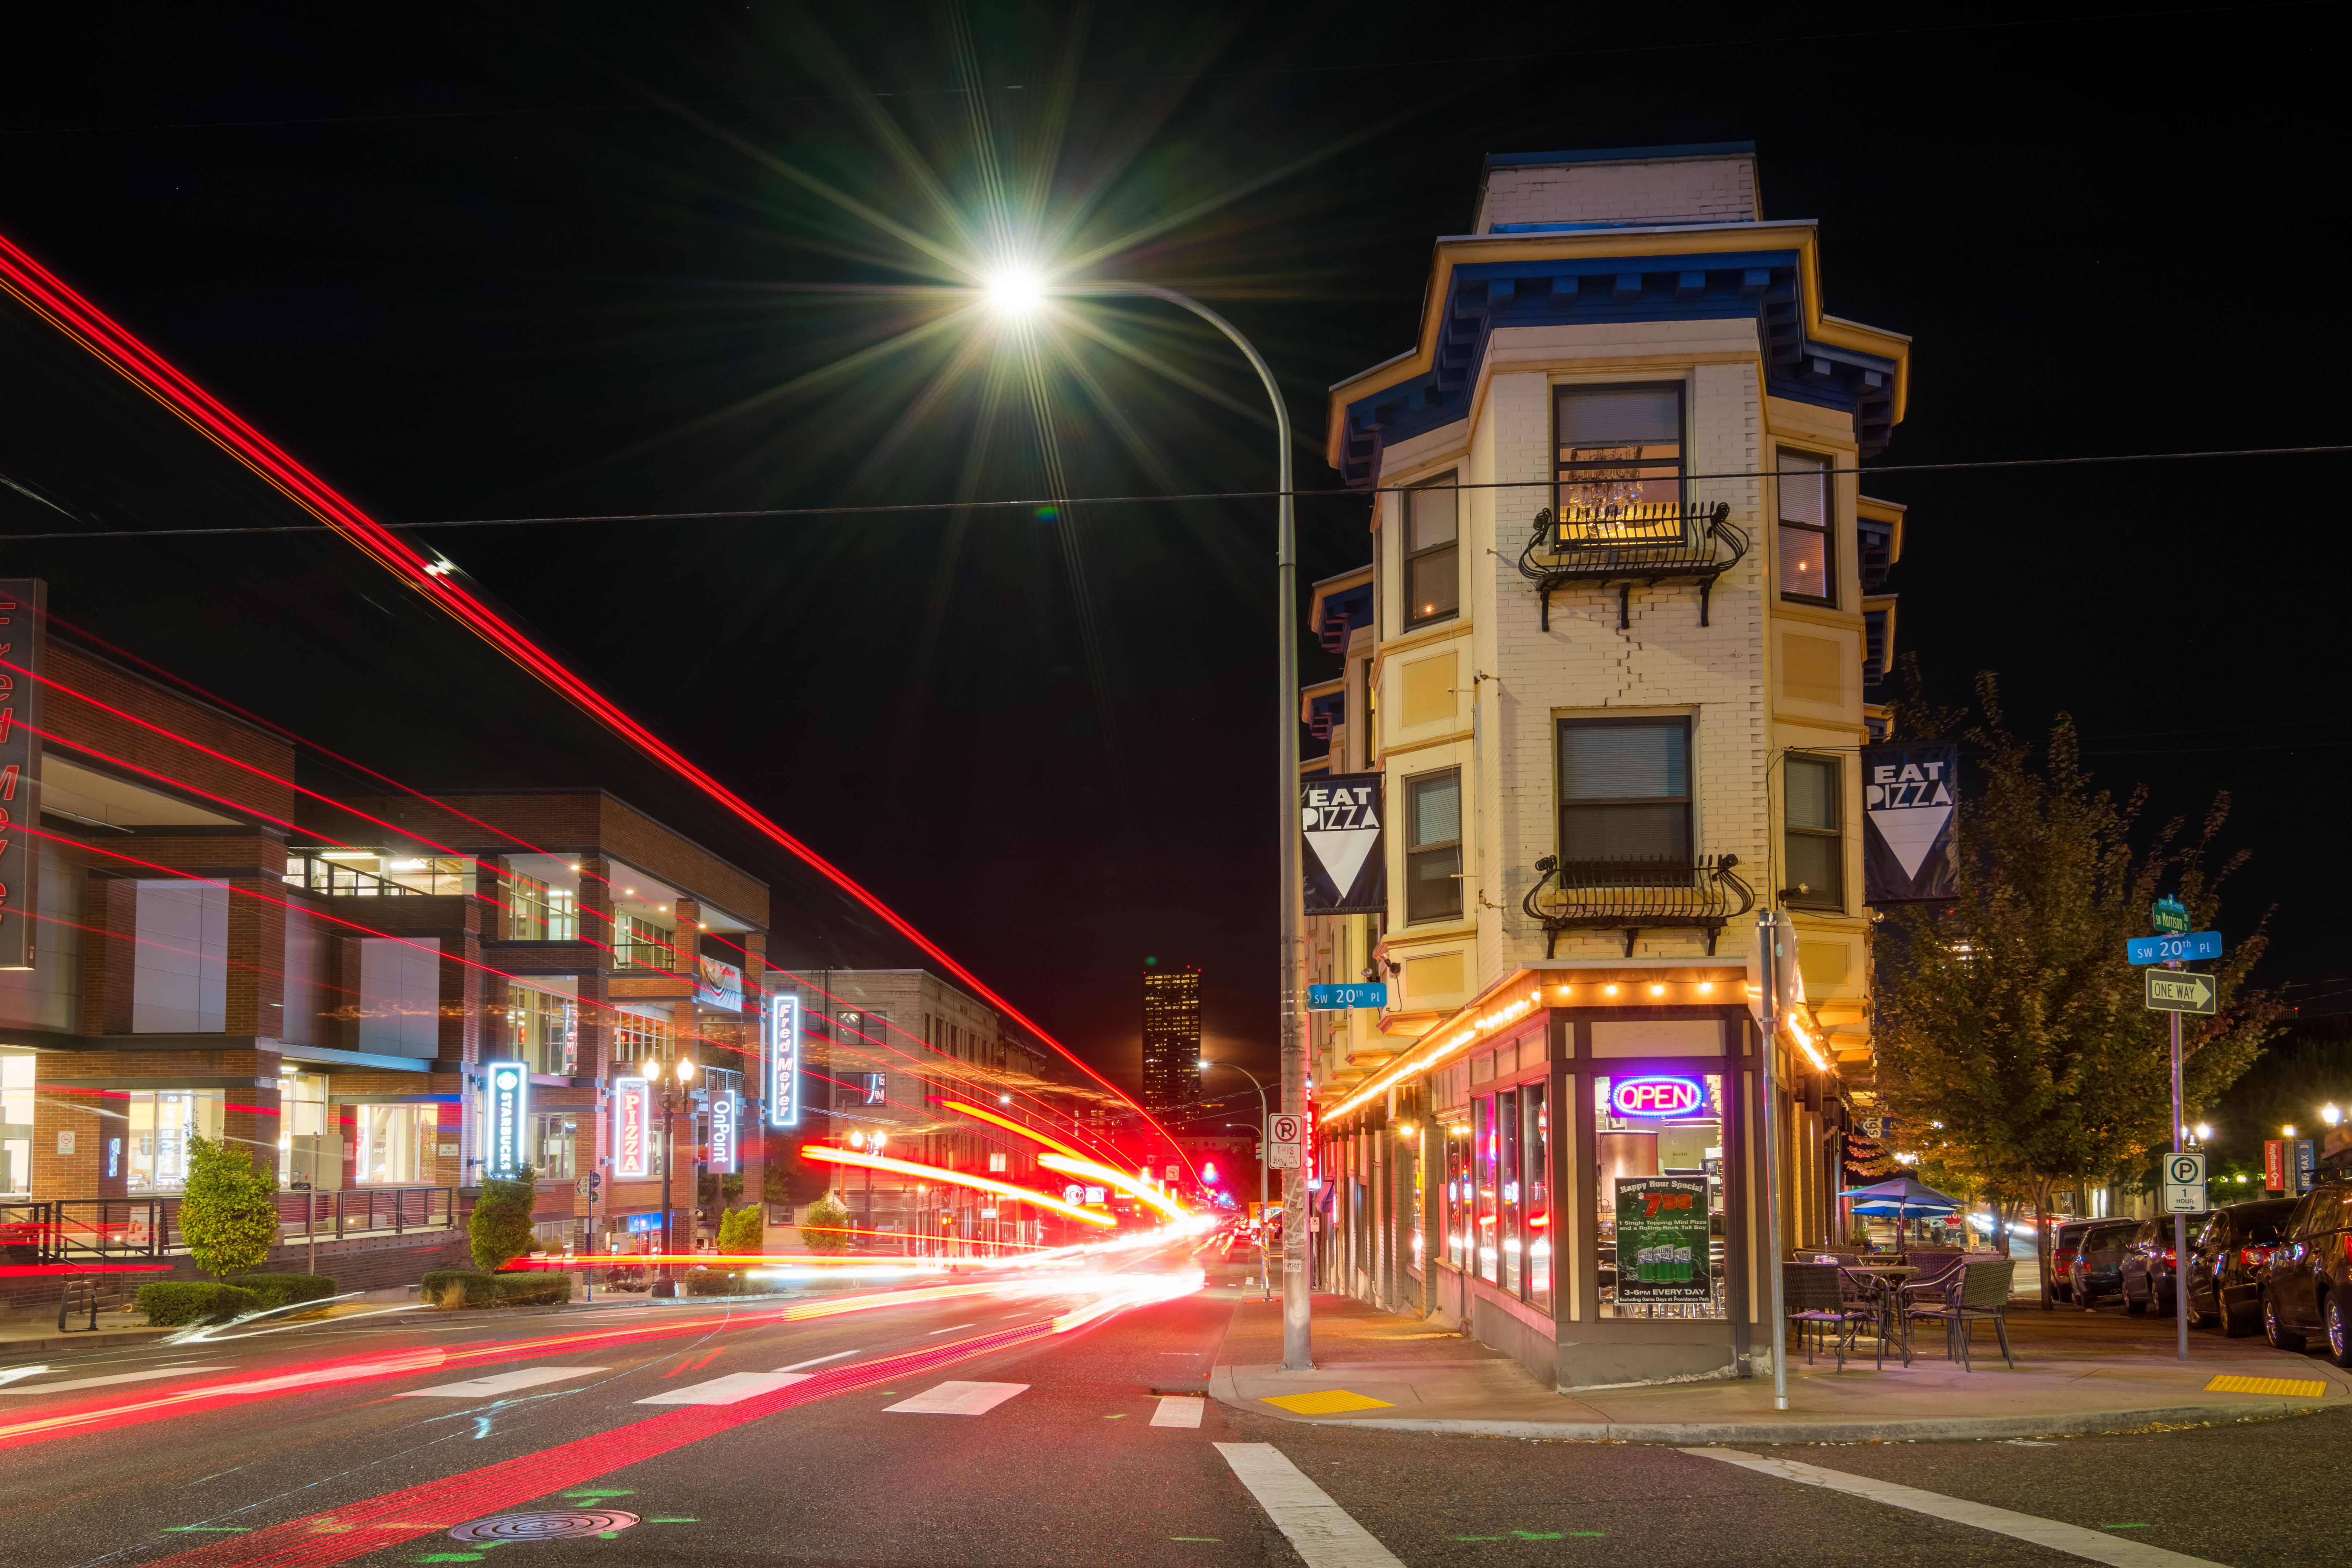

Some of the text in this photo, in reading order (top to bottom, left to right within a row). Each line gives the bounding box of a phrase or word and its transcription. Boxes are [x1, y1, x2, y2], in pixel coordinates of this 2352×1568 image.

[1874, 762, 1944, 784] EAT
[1309, 787, 1371, 807] EAT
[1867, 781, 1952, 809] PIZZA
[1302, 805, 1380, 831] PIZZA
[2162, 912, 2182, 930] Morrison
[2137, 940, 2210, 958] SW 20th Pl
[1315, 989, 1380, 1004] SW 20th Pl
[2155, 983, 2194, 1000] ONE WAY
[777, 1004, 793, 1116] Fred Meyer
[1619, 1085, 1692, 1109] OPEN
[500, 1092, 512, 1170] STARBUCKS
[624, 1095, 640, 1170] PIZZA
[713, 1101, 730, 1163] OnPoint
[1277, 1146, 1294, 1155] THIS
[2269, 1144, 2277, 1172] KeyBank
[2179, 1163, 2193, 1179] P
[1620, 1183, 1647, 1193] Happy
[1671, 1180, 1703, 1192] Special
[2182, 1188, 2186, 1197] 1
